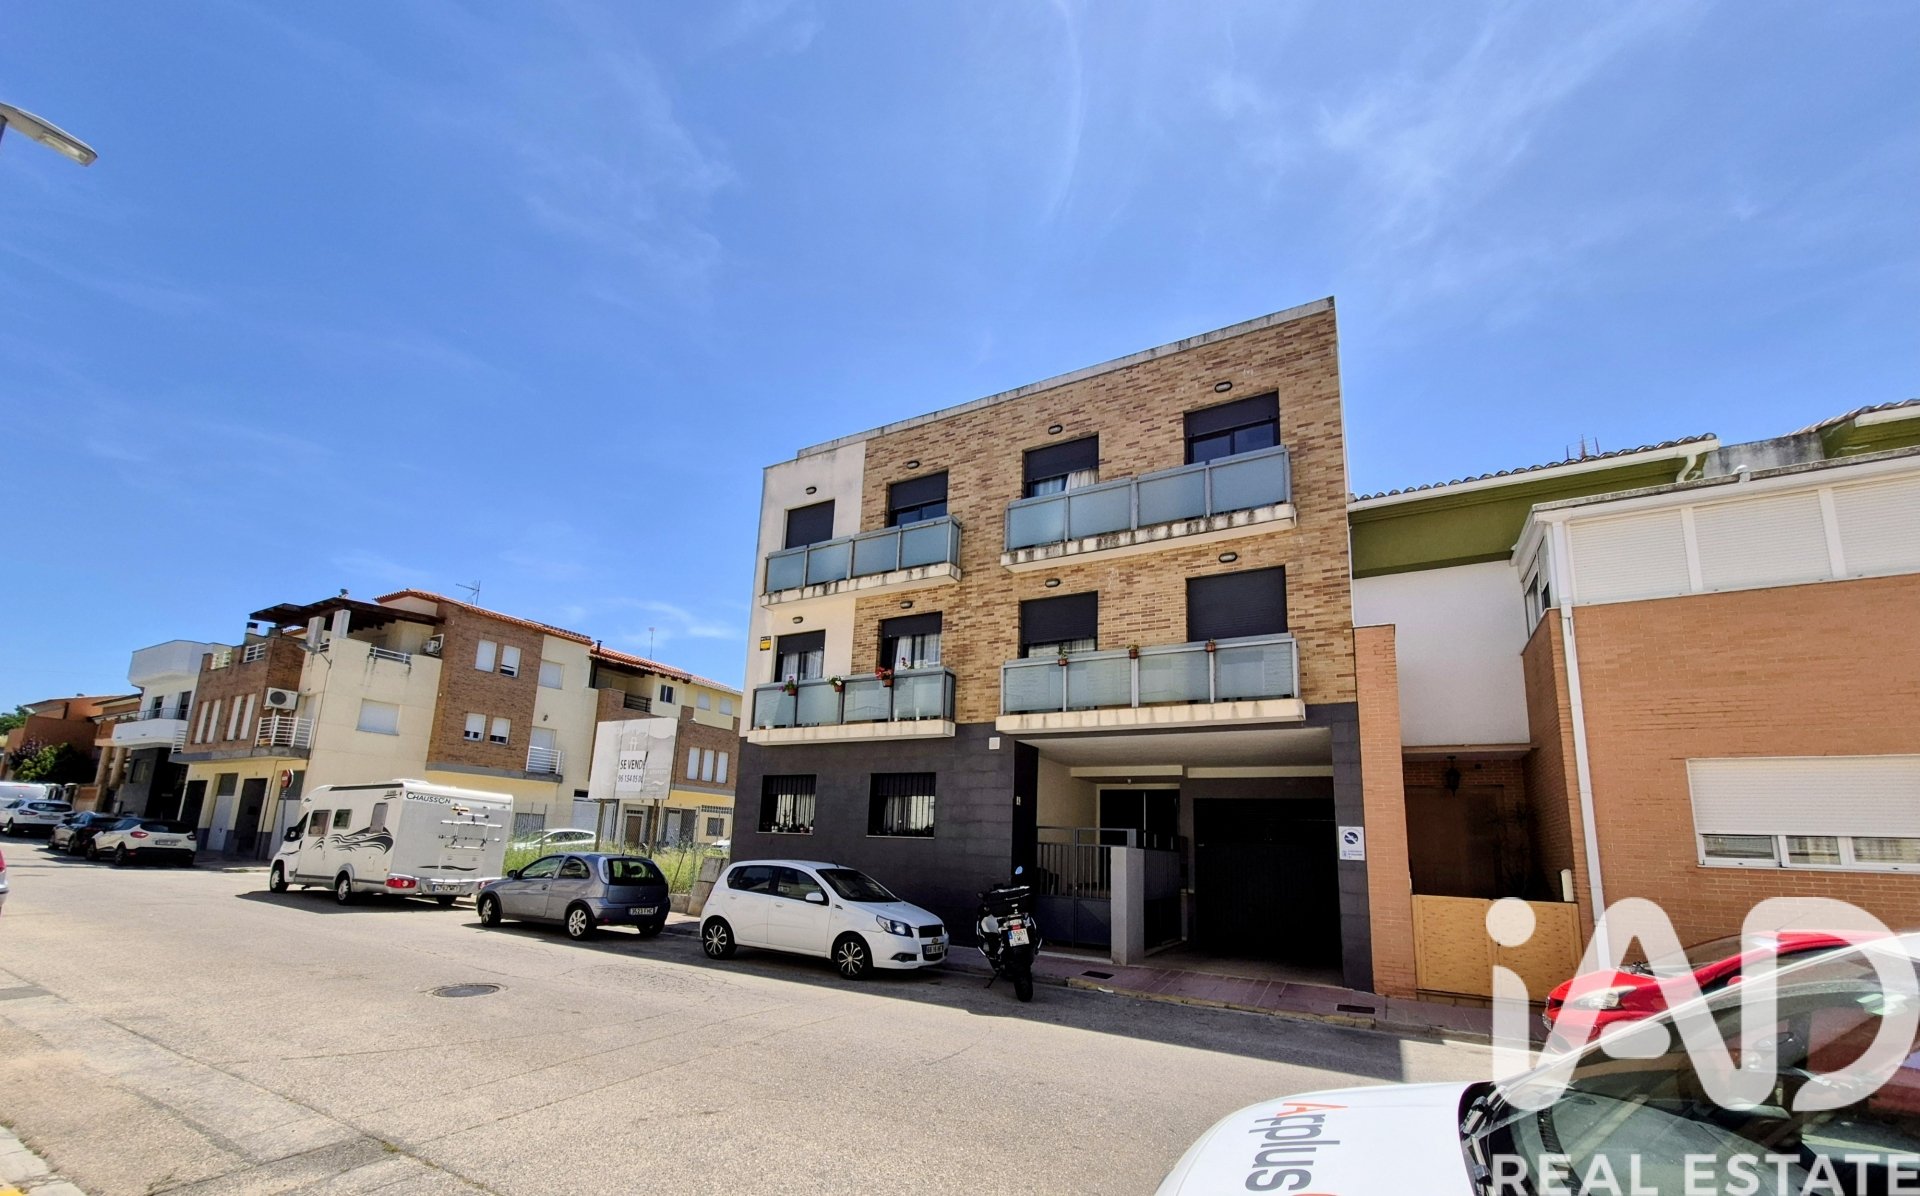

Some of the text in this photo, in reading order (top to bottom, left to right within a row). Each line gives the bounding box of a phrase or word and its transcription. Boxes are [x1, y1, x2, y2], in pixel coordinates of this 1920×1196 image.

[620, 759, 627, 770] SE
[406, 791, 451, 805] CHAUSSON
[1245, 1102, 1348, 1192] Applus
